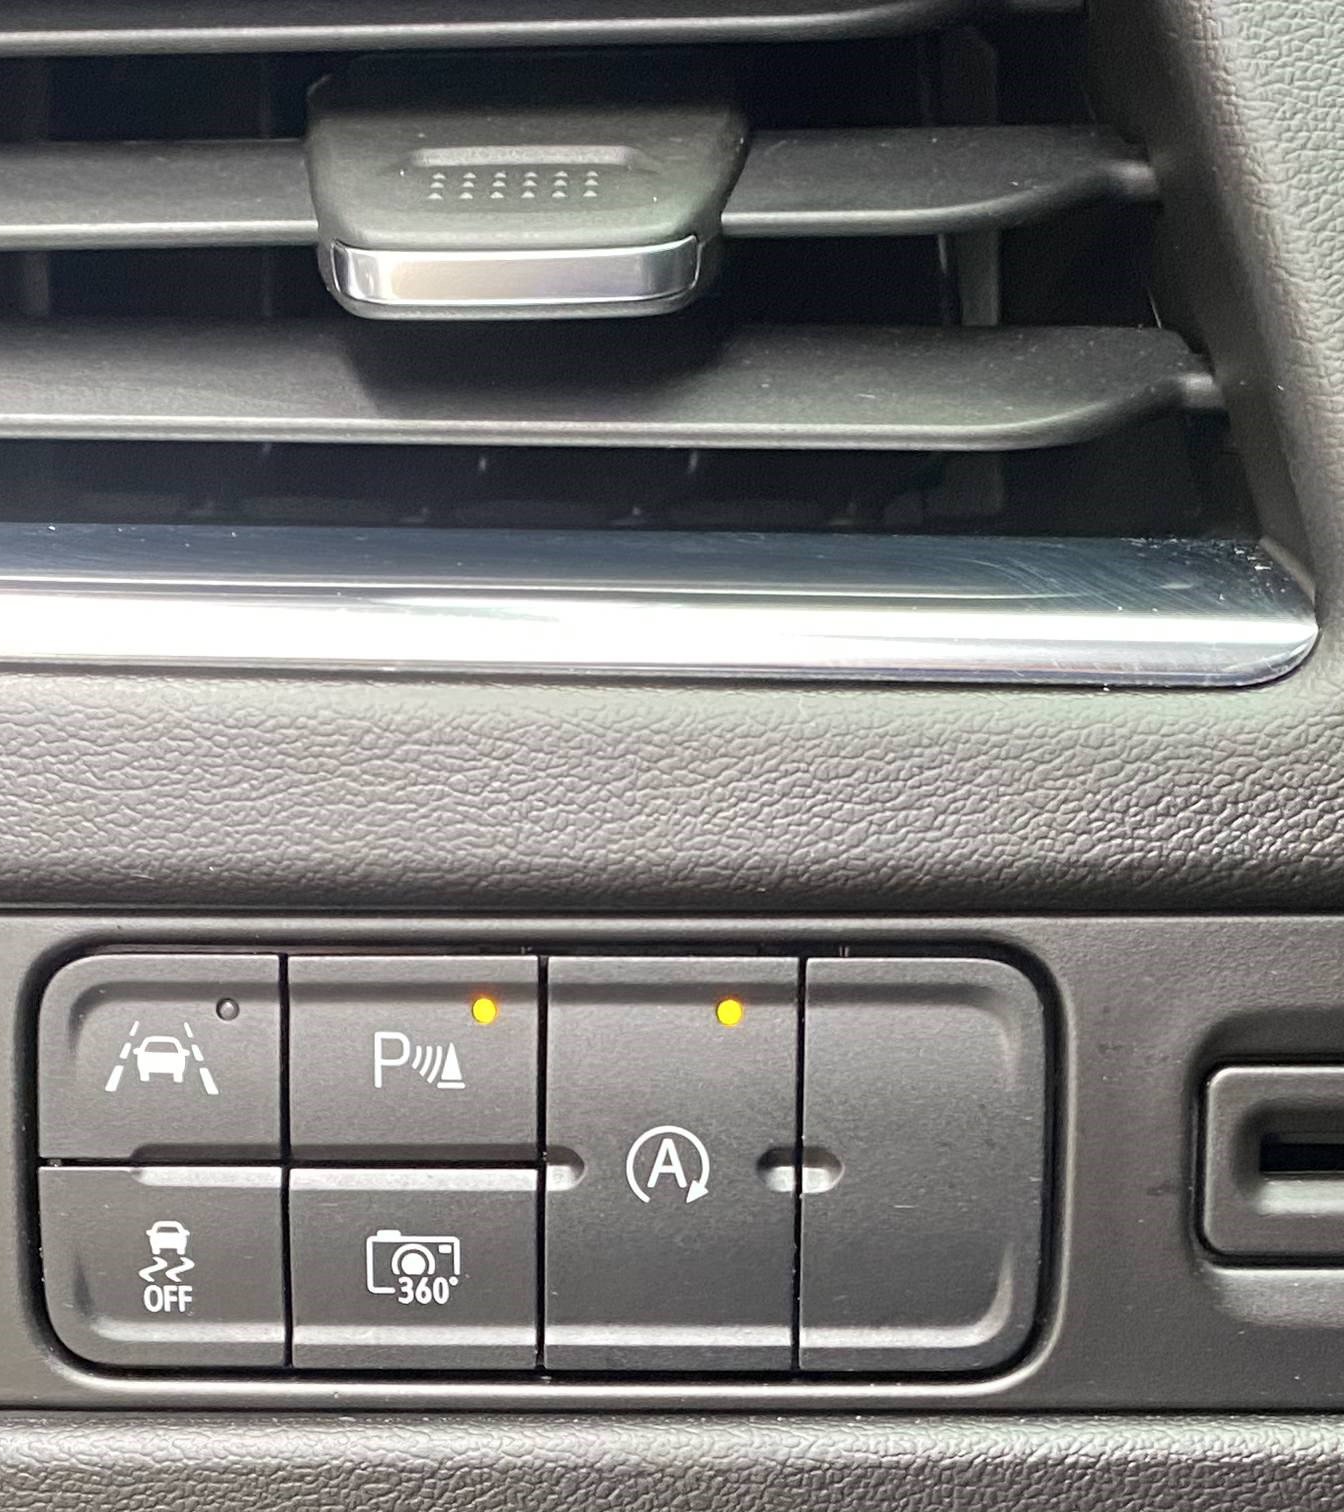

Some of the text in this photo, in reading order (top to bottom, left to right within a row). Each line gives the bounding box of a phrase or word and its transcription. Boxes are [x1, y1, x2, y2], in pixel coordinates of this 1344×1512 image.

[373, 1031, 411, 1088] P
[647, 1138, 687, 1188] A
[143, 1284, 193, 1312] OFF
